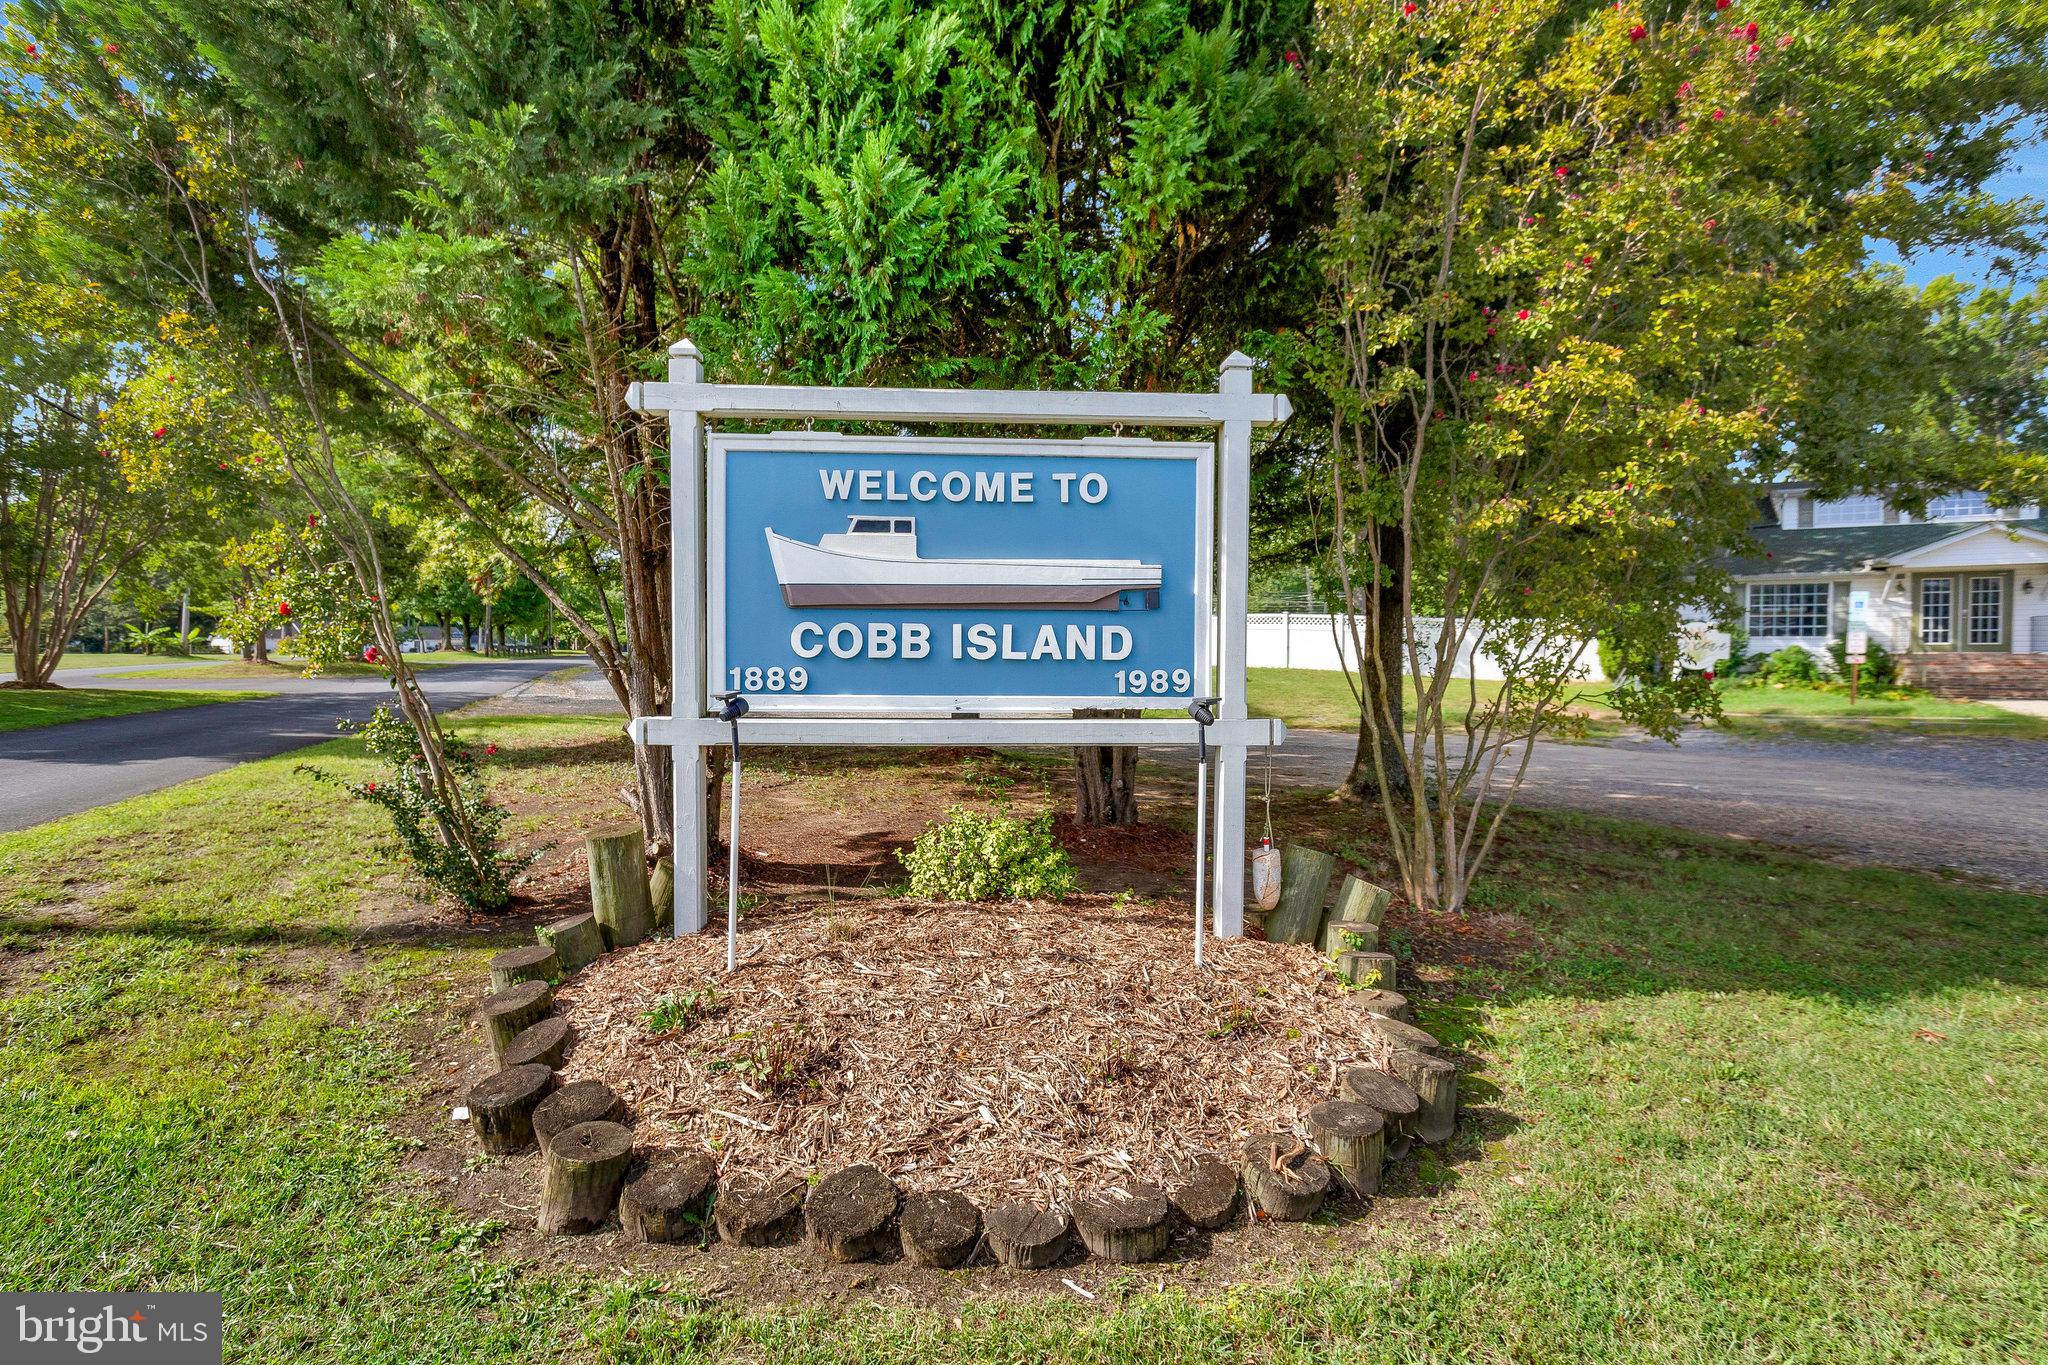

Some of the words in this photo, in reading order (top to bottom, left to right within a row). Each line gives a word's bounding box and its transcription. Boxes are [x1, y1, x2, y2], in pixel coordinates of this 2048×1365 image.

[818, 469, 1034, 502] WELCOME
[1052, 473, 1109, 504] TO
[790, 621, 931, 660] COBB
[952, 623, 1134, 661] ISLAND
[729, 667, 809, 692] 1889
[1114, 669, 1191, 694] 1989
